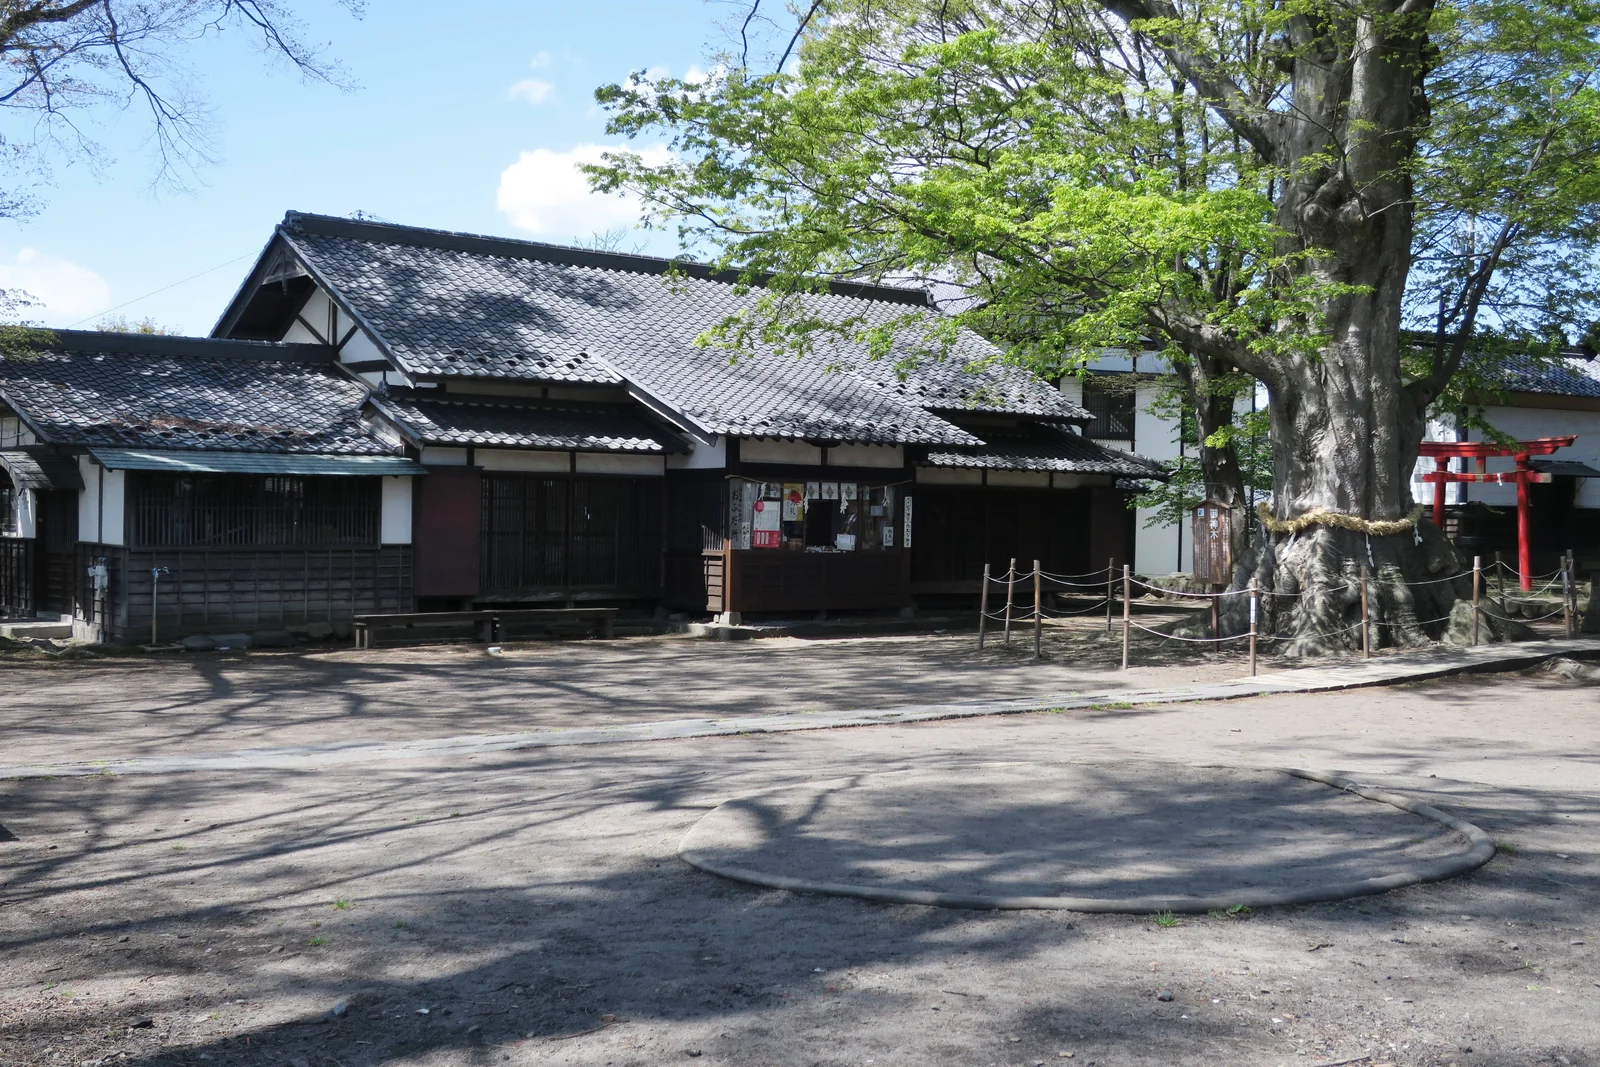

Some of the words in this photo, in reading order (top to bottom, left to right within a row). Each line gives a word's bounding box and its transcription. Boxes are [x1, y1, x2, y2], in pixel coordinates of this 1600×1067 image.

[731, 489, 739, 541] おふだ所
[1209, 508, 1219, 540] 御神木
